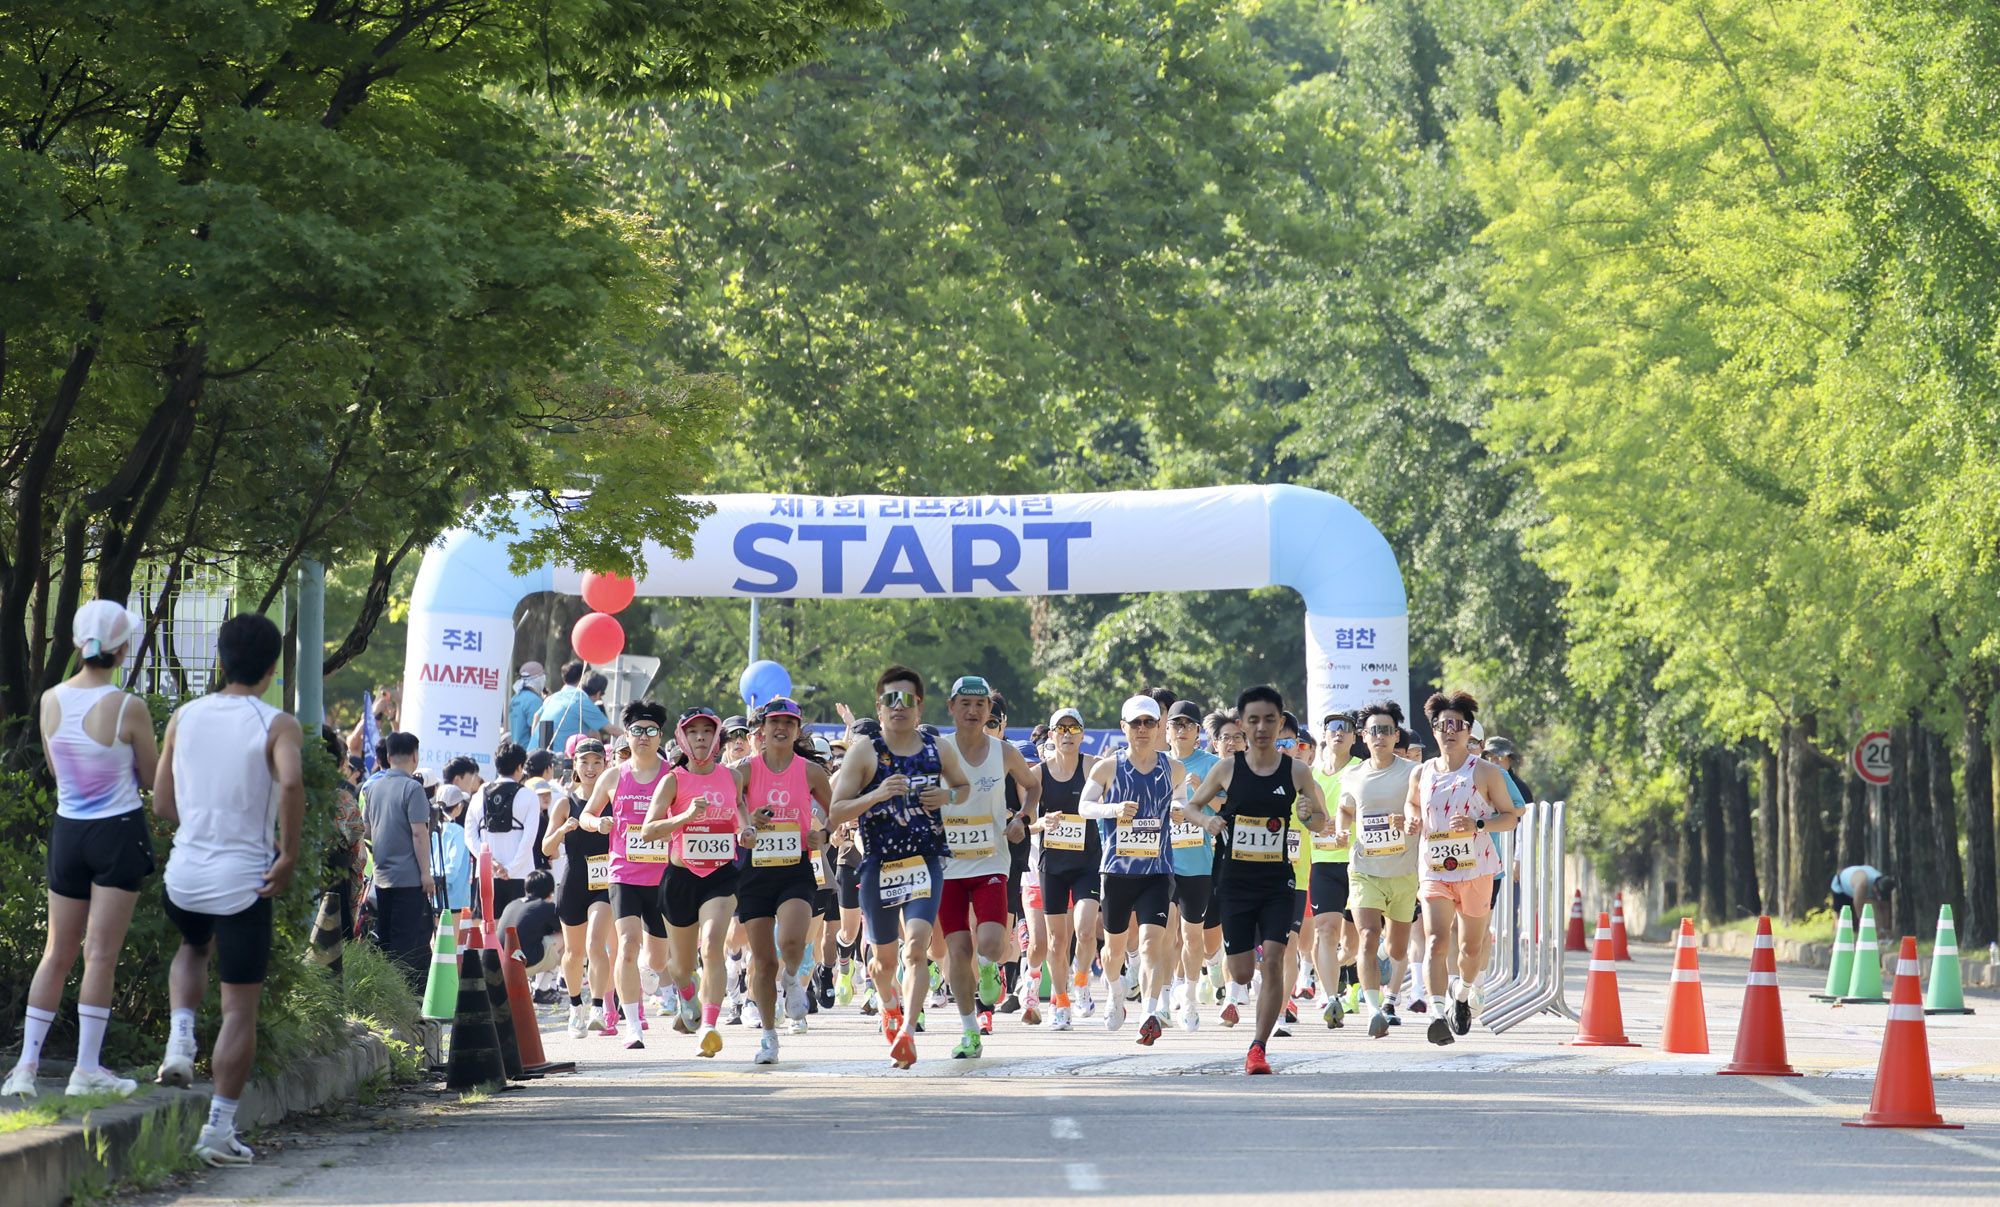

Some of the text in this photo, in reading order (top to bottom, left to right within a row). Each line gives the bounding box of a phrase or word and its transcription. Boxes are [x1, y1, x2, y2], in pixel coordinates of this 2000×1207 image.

[879, 496, 1053, 518] 리프레시런
[731, 521, 1092, 594] START
[442, 628, 483, 652] 주최
[1335, 628, 1376, 649] 협찬
[419, 663, 500, 690] 시사저널
[438, 714, 479, 738] 주관
[1867, 743, 1890, 764] 20
[948, 829, 989, 844] 2121
[1047, 825, 1082, 838] 2325
[1120, 830, 1157, 844] 2329
[1236, 831, 1280, 847] 2117
[1365, 829, 1401, 843] 2319
[629, 837, 665, 850] 2214
[687, 839, 730, 853] 7036
[755, 837, 797, 852] 2313
[1431, 842, 1470, 859] 2364
[883, 871, 927, 888] 2243
[886, 887, 907, 897] 0803
